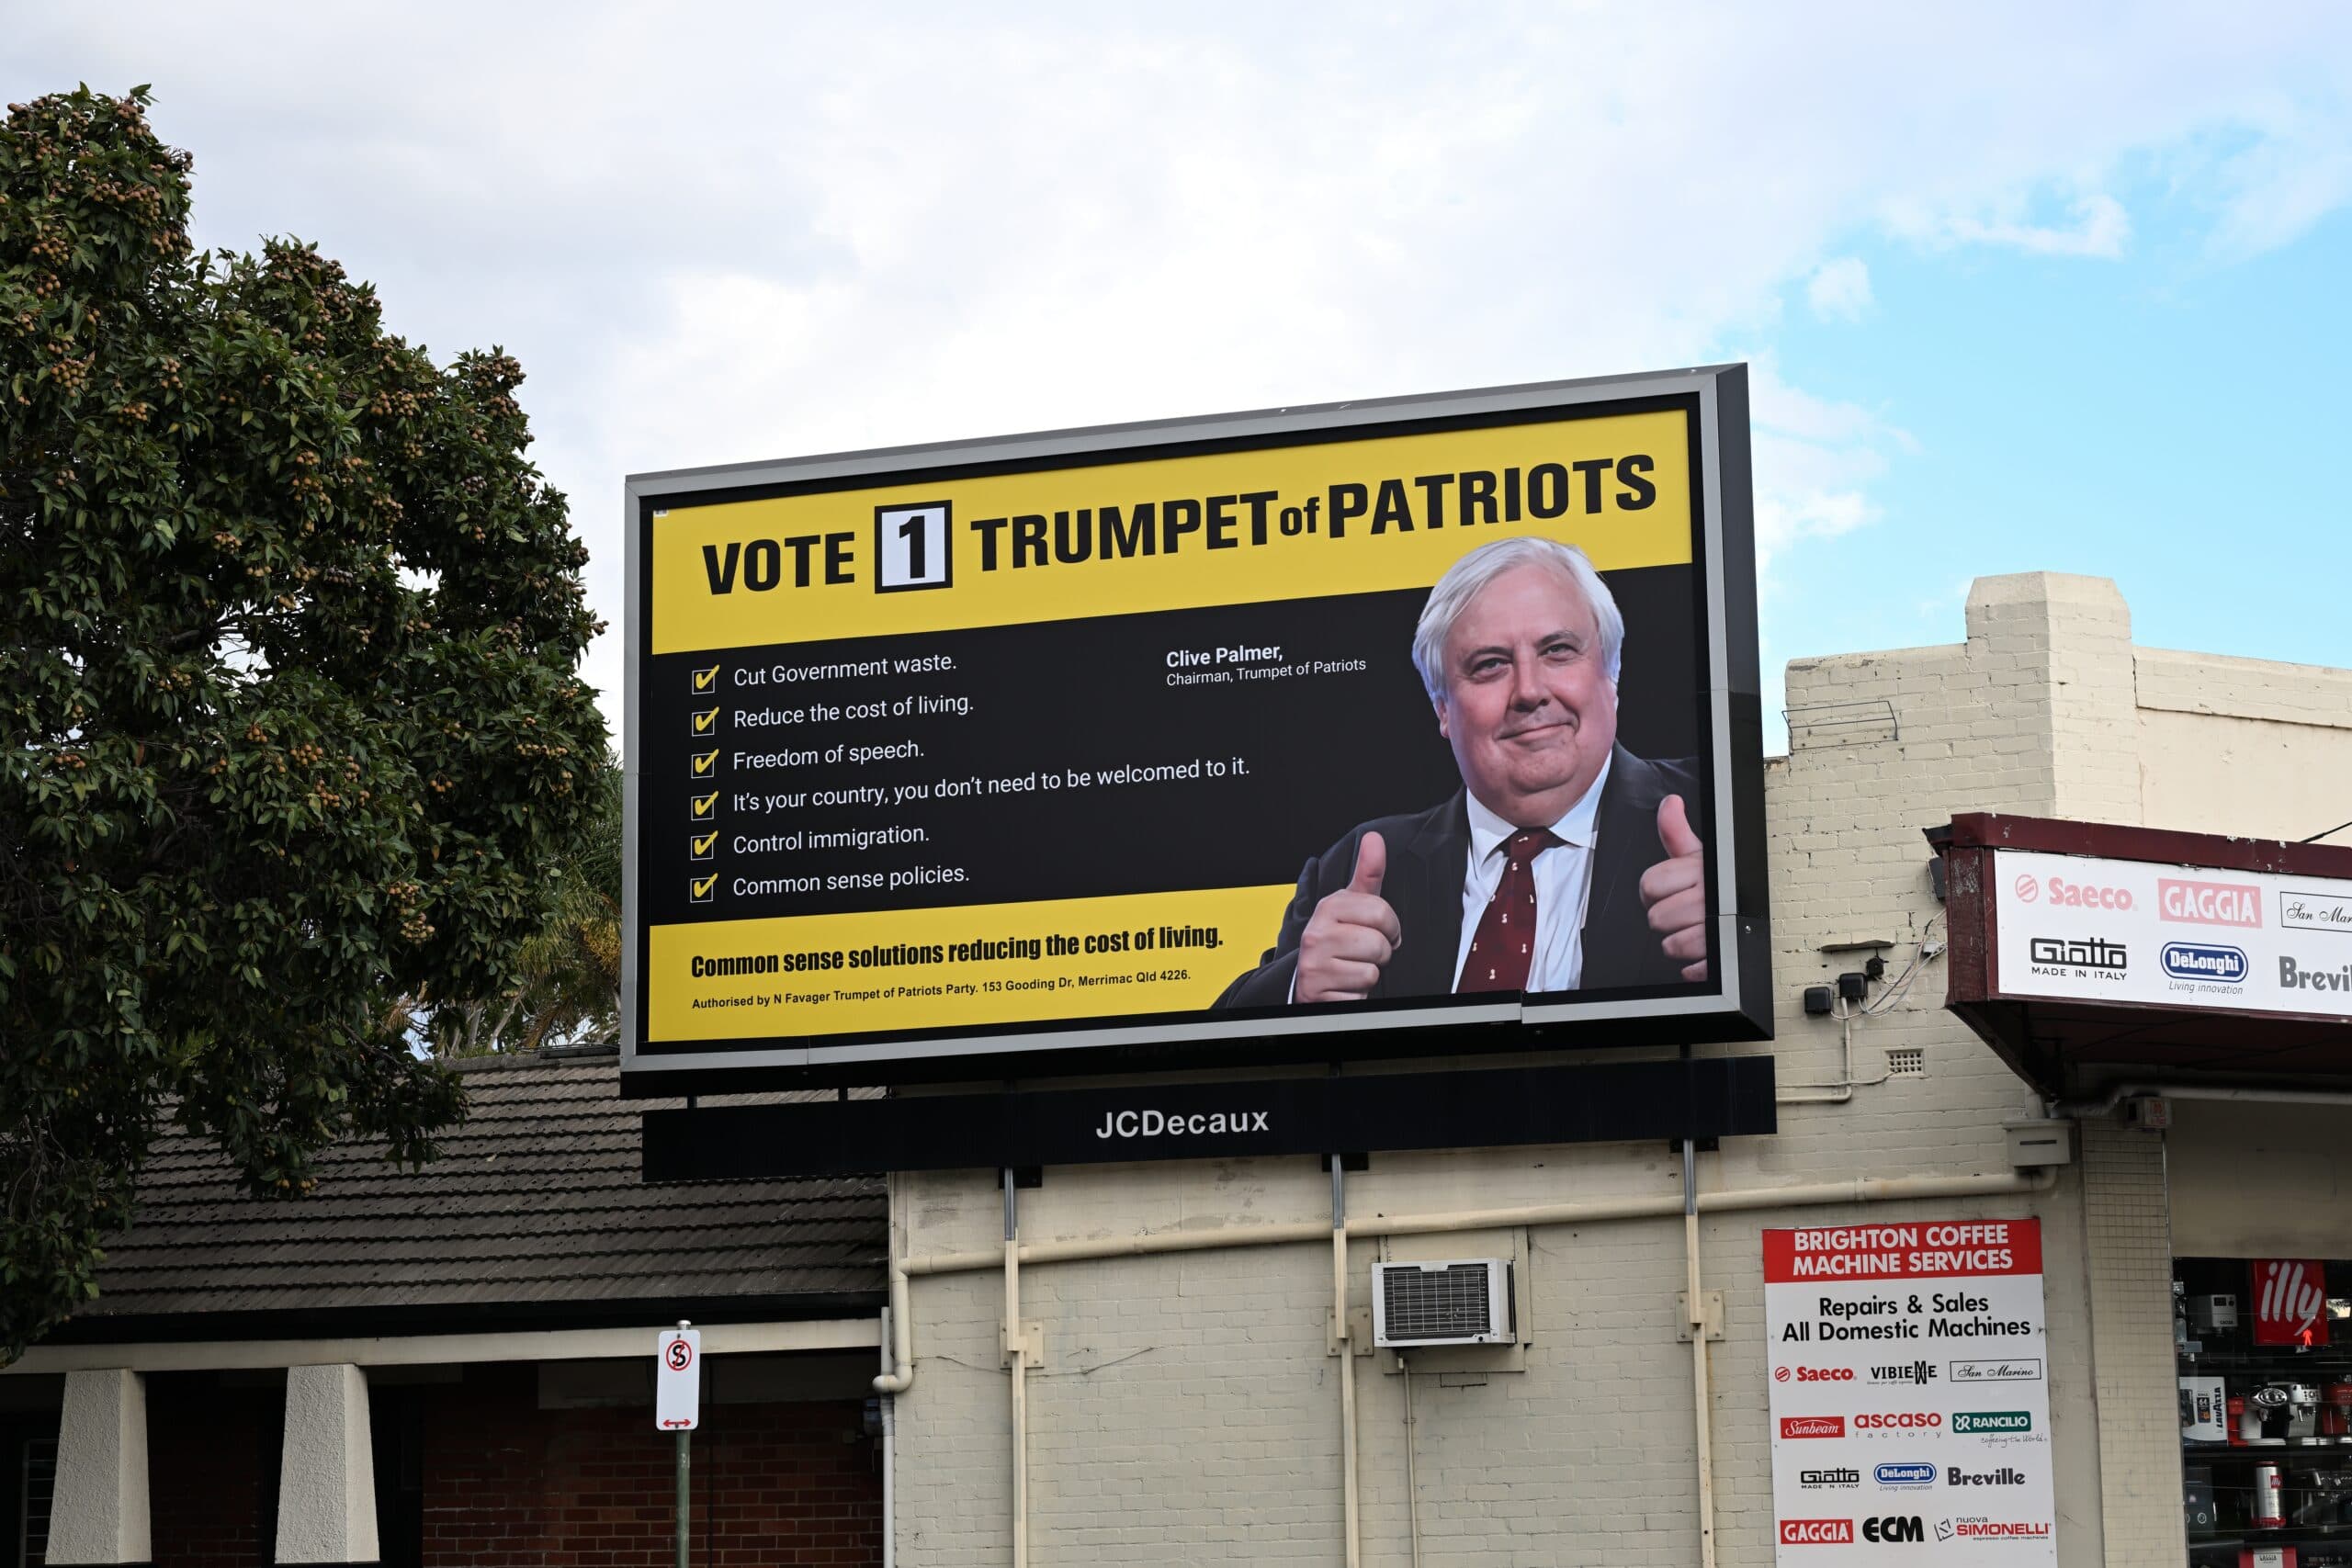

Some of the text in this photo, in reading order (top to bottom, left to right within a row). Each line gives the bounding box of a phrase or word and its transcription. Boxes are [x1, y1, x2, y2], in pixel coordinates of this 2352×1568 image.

[702, 454, 1657, 595] VOTE 1 TRUMPET of PATRIOTS
[734, 653, 956, 686] Cut Government waste.
[1166, 645, 1283, 668] Clive Palmer,
[1166, 659, 1366, 686] Chairman, Trumpet of Patriots
[734, 694, 974, 728] Reduce the cost of living.
[733, 739, 924, 770] Freedom of speech.
[734, 756, 1250, 814] It's your country, you don't need to be welcomed to it.
[734, 826, 930, 854] Control immigration.
[733, 864, 970, 897] Common sense policies.
[2049, 876, 2133, 911] Saeco
[2164, 885, 2256, 923] GAGGIA
[2287, 901, 2313, 920] San
[691, 925, 1224, 977] Common sense solutions reducing the cost of living.
[2030, 936, 2127, 970] Giotto
[2031, 966, 2128, 981] MADE IN ITALY
[692, 969, 1192, 1009] Authorised by N Favager Trumpet of Patriots Party. 153 Gooding Dr, Merrimac Qld 4226.
[2168, 980, 2244, 995] Living innovation
[1096, 1110, 1270, 1139] JCDecaux
[1794, 1224, 2009, 1251] BRIGHTON COFFEE
[1792, 1249, 2013, 1276] MACHINE SERVICES
[1819, 1292, 1989, 1321] Repairs & Sales
[2261, 1261, 2323, 1337] illy
[1782, 1316, 2030, 1342] All Domestic Machines
[1797, 1366, 1854, 1382] Saeco
[1957, 1364, 2034, 1378] San Marino
[1785, 1419, 1839, 1436] Sunbeam
[1854, 1413, 1941, 1428] ascaso
[1973, 1416, 2028, 1427] RANCILIO
[1801, 1468, 1860, 1483] Giotto
[1948, 1467, 2026, 1486] Breville
[1784, 1521, 1850, 1541] GAGGIA
[1862, 1516, 1924, 1543] ECM
[1956, 1523, 2049, 1536] SIMONELLI
